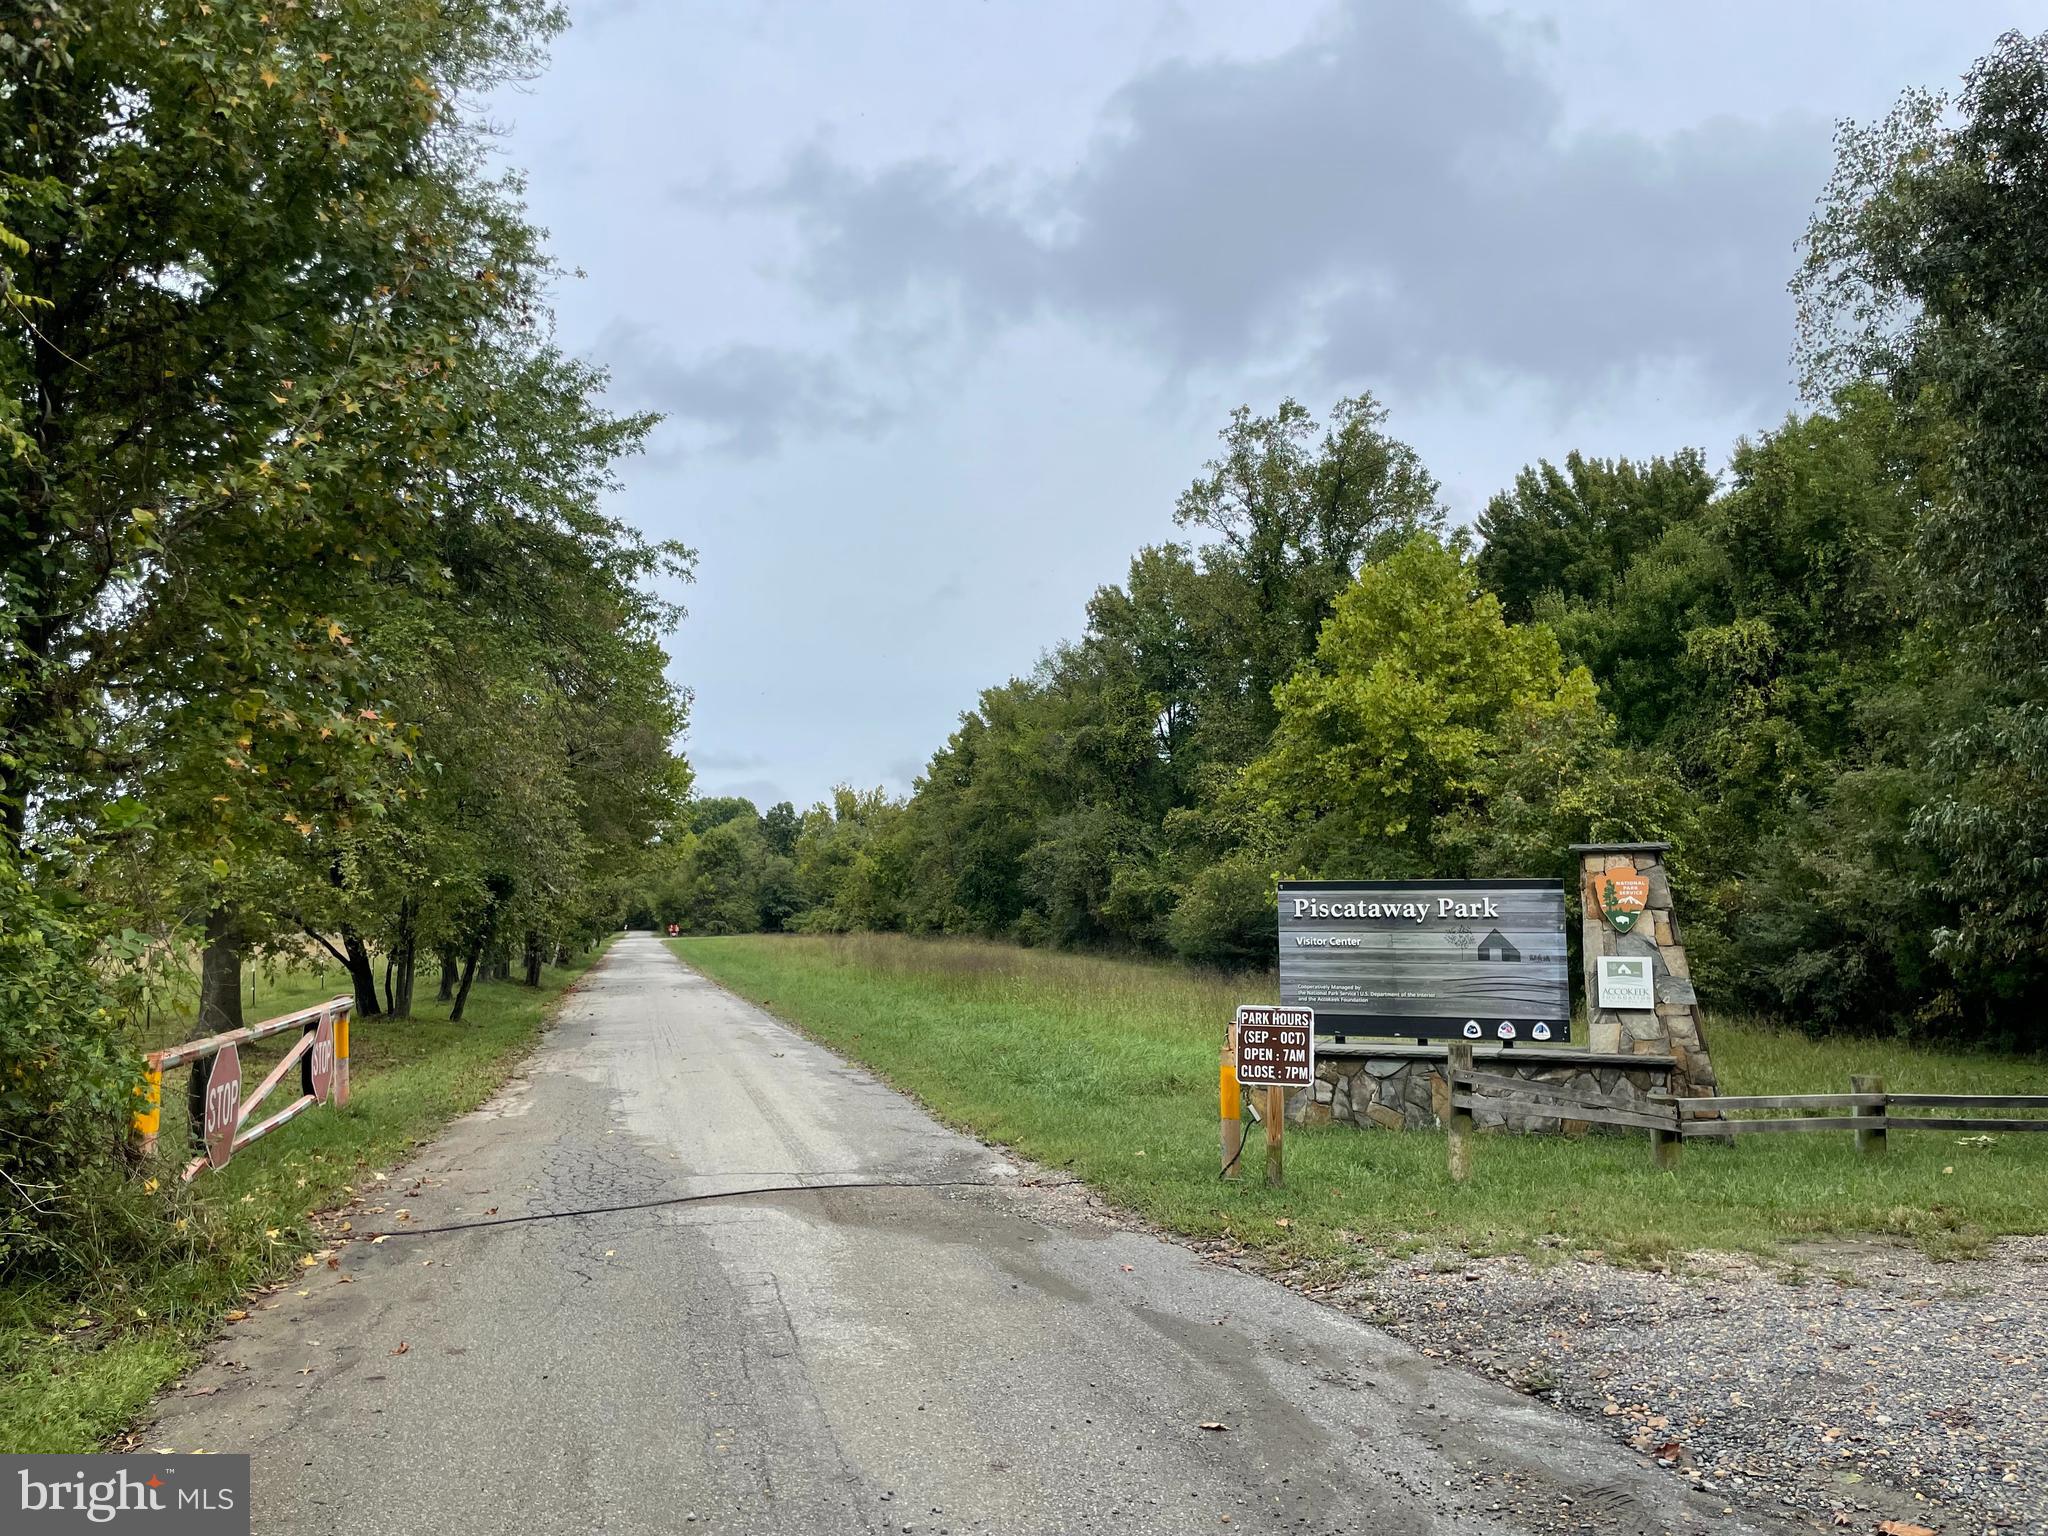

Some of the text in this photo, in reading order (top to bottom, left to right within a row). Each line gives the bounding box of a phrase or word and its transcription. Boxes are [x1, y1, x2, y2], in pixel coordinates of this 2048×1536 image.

[1293, 897, 1499, 923] Piscataway Park
[1296, 937, 1361, 946] Visitor Center
[1604, 987, 1648, 996] ACCOKEEK
[1241, 1012, 1309, 1026] PARK HOURS
[1244, 1030, 1269, 1044] (SEP
[1280, 1031, 1305, 1046] OCT)
[313, 1040, 331, 1076] STOP
[1244, 1047, 1273, 1061] OPEN
[1283, 1049, 1306, 1062] 7AM
[1241, 1064, 1275, 1078] CLOSE
[1285, 1066, 1309, 1080] 7PM
[208, 1080, 238, 1133] STOP
